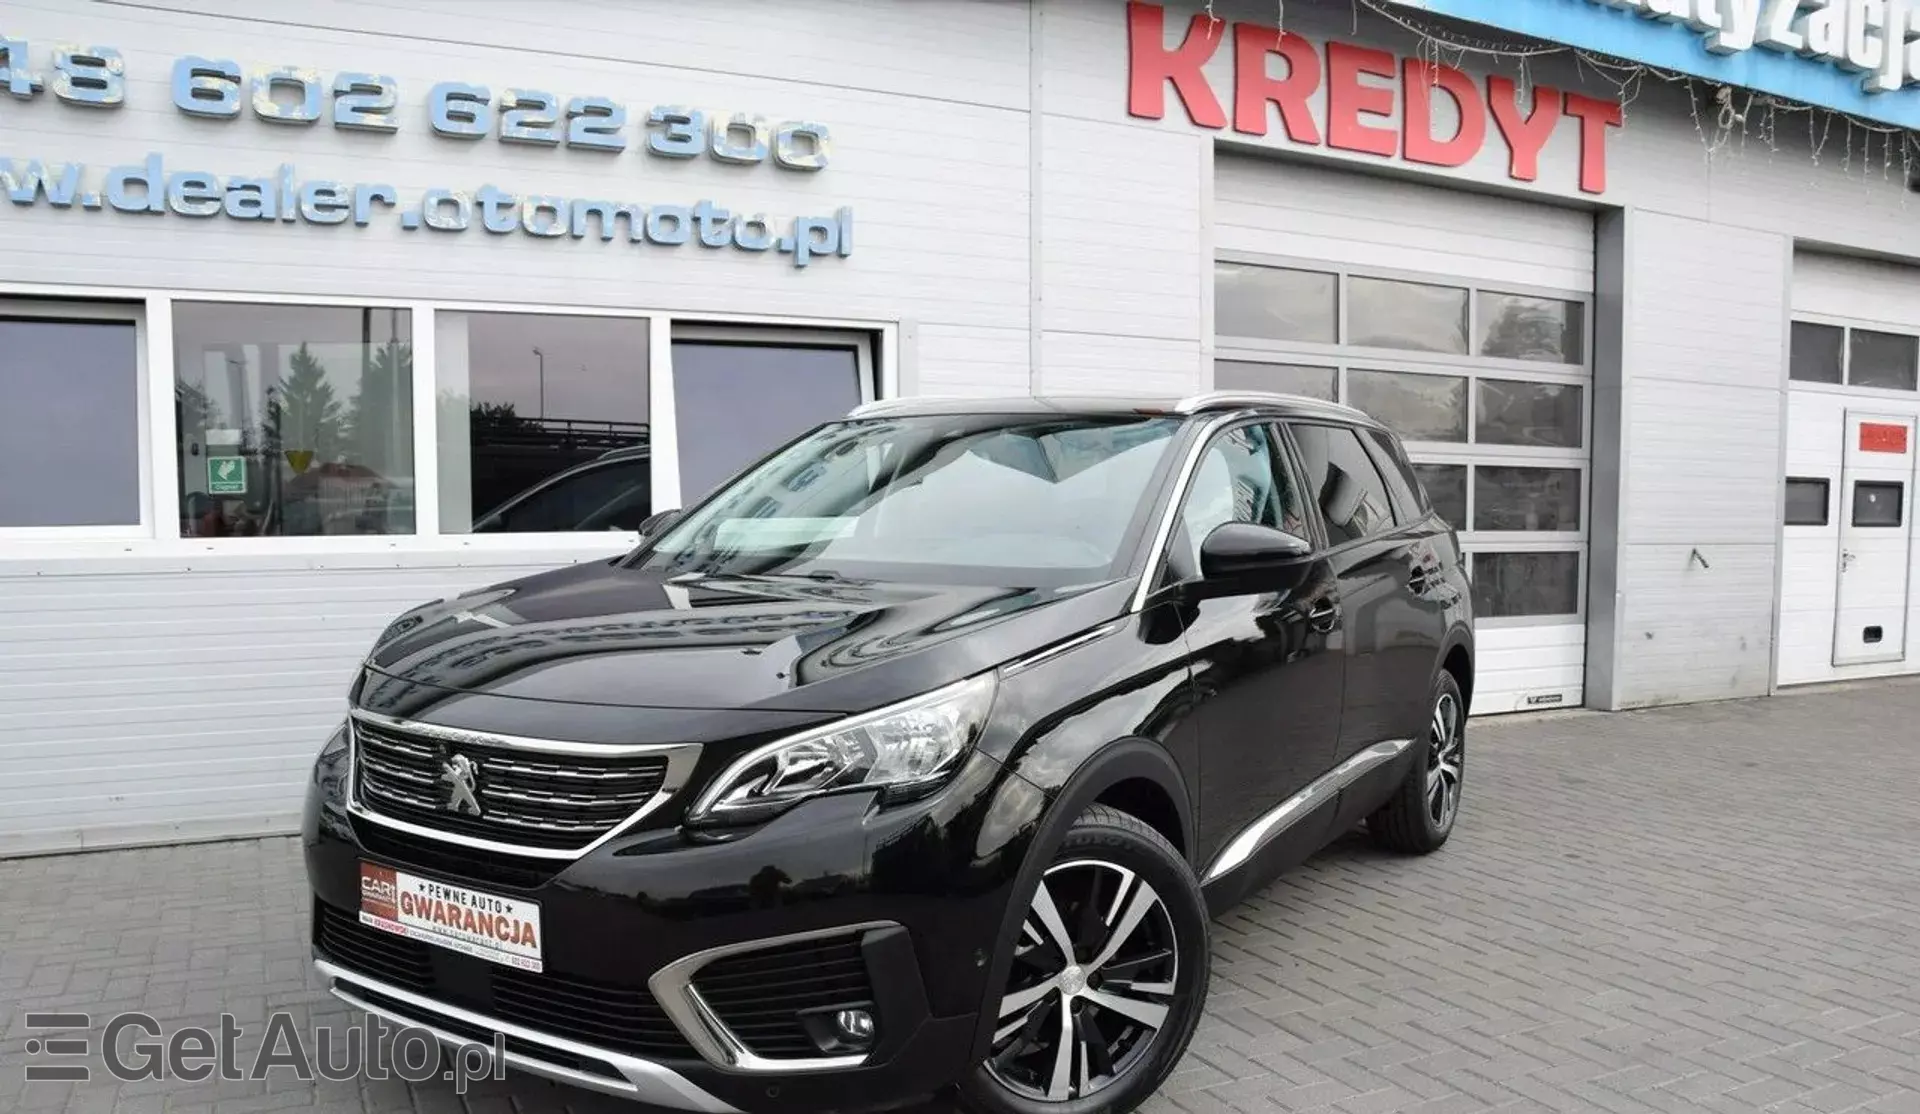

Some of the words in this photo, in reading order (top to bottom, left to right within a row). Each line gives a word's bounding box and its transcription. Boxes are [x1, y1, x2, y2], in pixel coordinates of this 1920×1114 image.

[171, 54, 399, 134] 602
[427, 80, 626, 153] 622
[645, 103, 833, 172] 300
[1127, 2, 1623, 194] KREDYT
[400, 891, 538, 949] GWARANCJA
[428, 883, 467, 905] PEWNE
[471, 895, 503, 913] AUTO
